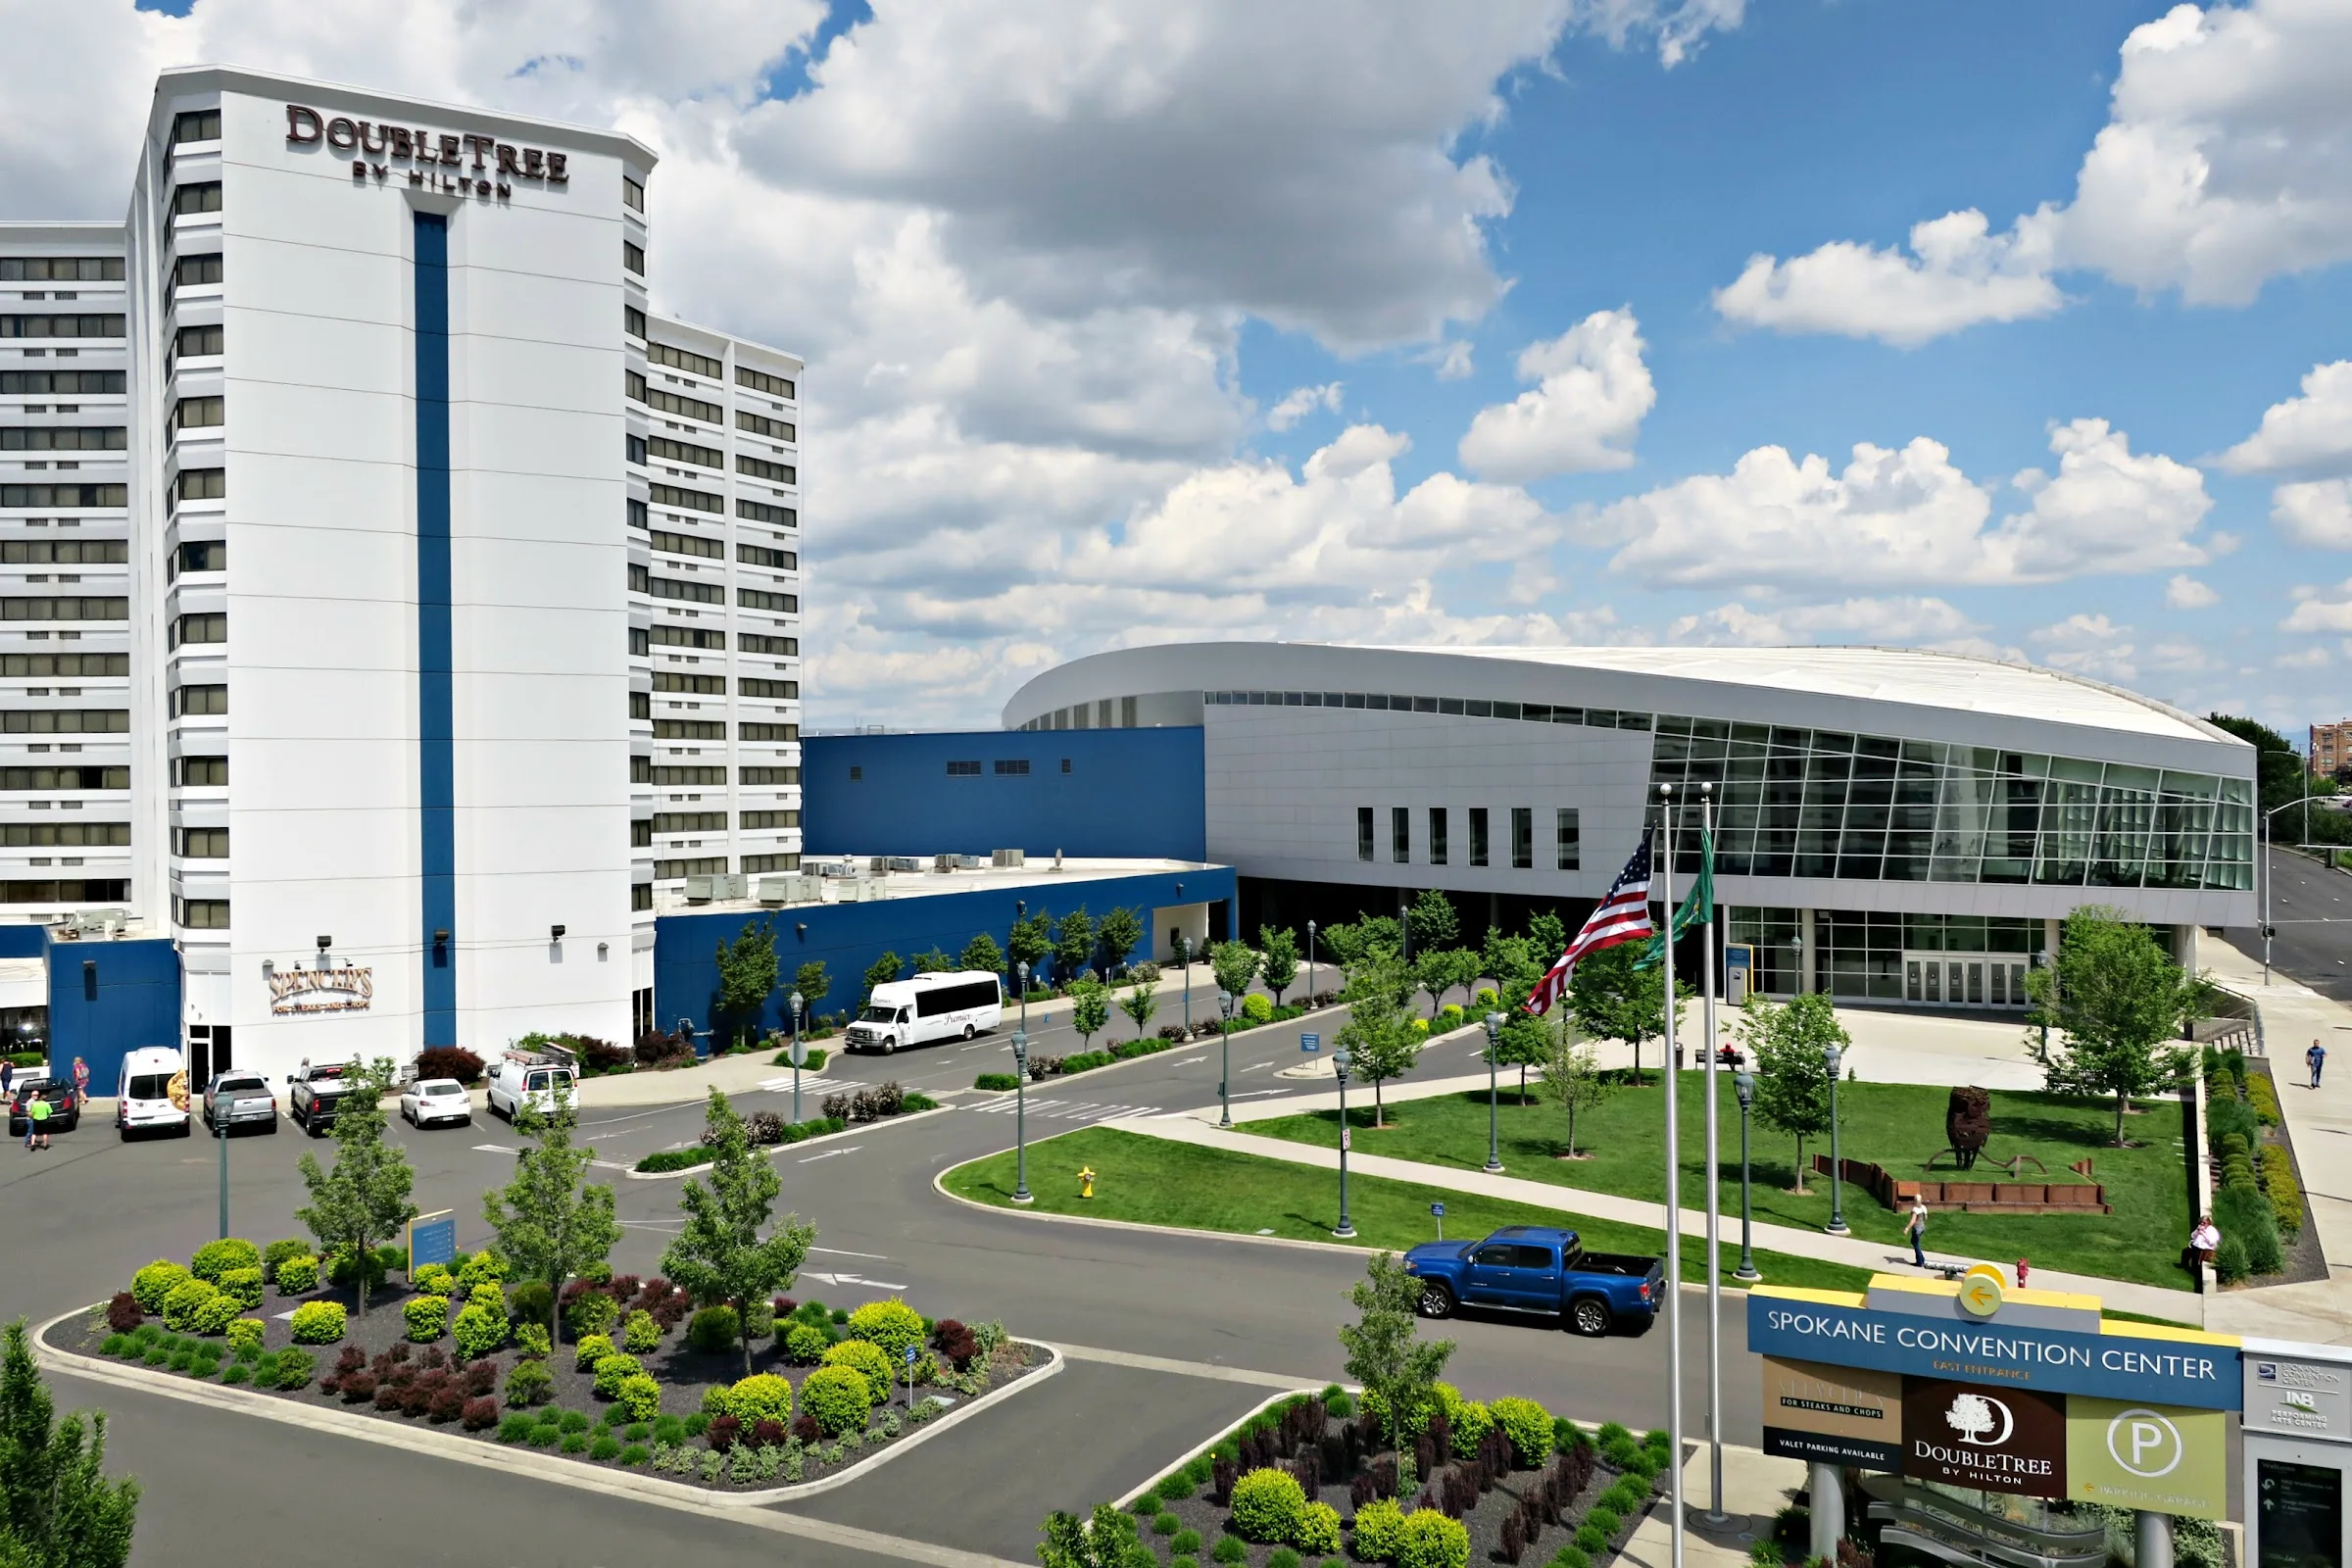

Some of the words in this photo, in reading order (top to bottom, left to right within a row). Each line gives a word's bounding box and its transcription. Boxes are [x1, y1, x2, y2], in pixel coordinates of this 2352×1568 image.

[353, 161, 387, 179] BY
[409, 169, 513, 198] HILTON
[270, 967, 372, 1004] SPENCER'S
[273, 1004, 289, 1013] FOR
[293, 1004, 322, 1012] STEAKS
[325, 1002, 342, 1011] AND
[345, 1000, 370, 1009] CHOPS
[945, 1013, 970, 1025] Premier
[1768, 1310, 1886, 1345] SPOKANE
[1896, 1327, 2090, 1368] CONVENTION
[2101, 1350, 2216, 1381] CENTER
[1933, 1360, 1960, 1371] EAST
[1965, 1365, 2031, 1381] ENTRANCE
[2281, 1362, 2322, 1374] SPOKANE
[2281, 1369, 2340, 1383] CONVENTION
[2281, 1376, 2315, 1387] CENTER
[1782, 1397, 1798, 1406] FOR
[1801, 1399, 1831, 1411] STEAKS
[1834, 1404, 1851, 1414] AND
[1853, 1408, 1882, 1418] CHOPS
[2285, 1391, 2315, 1407] INB
[2271, 1409, 2328, 1423] PERFORMING
[2271, 1416, 2292, 1426] ARTS
[2294, 1419, 2328, 1430] CENTER
[1779, 1439, 1803, 1449] VALET
[1806, 1443, 1839, 1454] PARKING
[1841, 1447, 1886, 1461] AVAILABLE
[2132, 1422, 2163, 1465] P
[1942, 1466, 1960, 1476] BY
[1969, 1471, 2023, 1486] HILTON
[2099, 1485, 2154, 1501] PARKING
[2157, 1494, 2211, 1508] GARAGE
